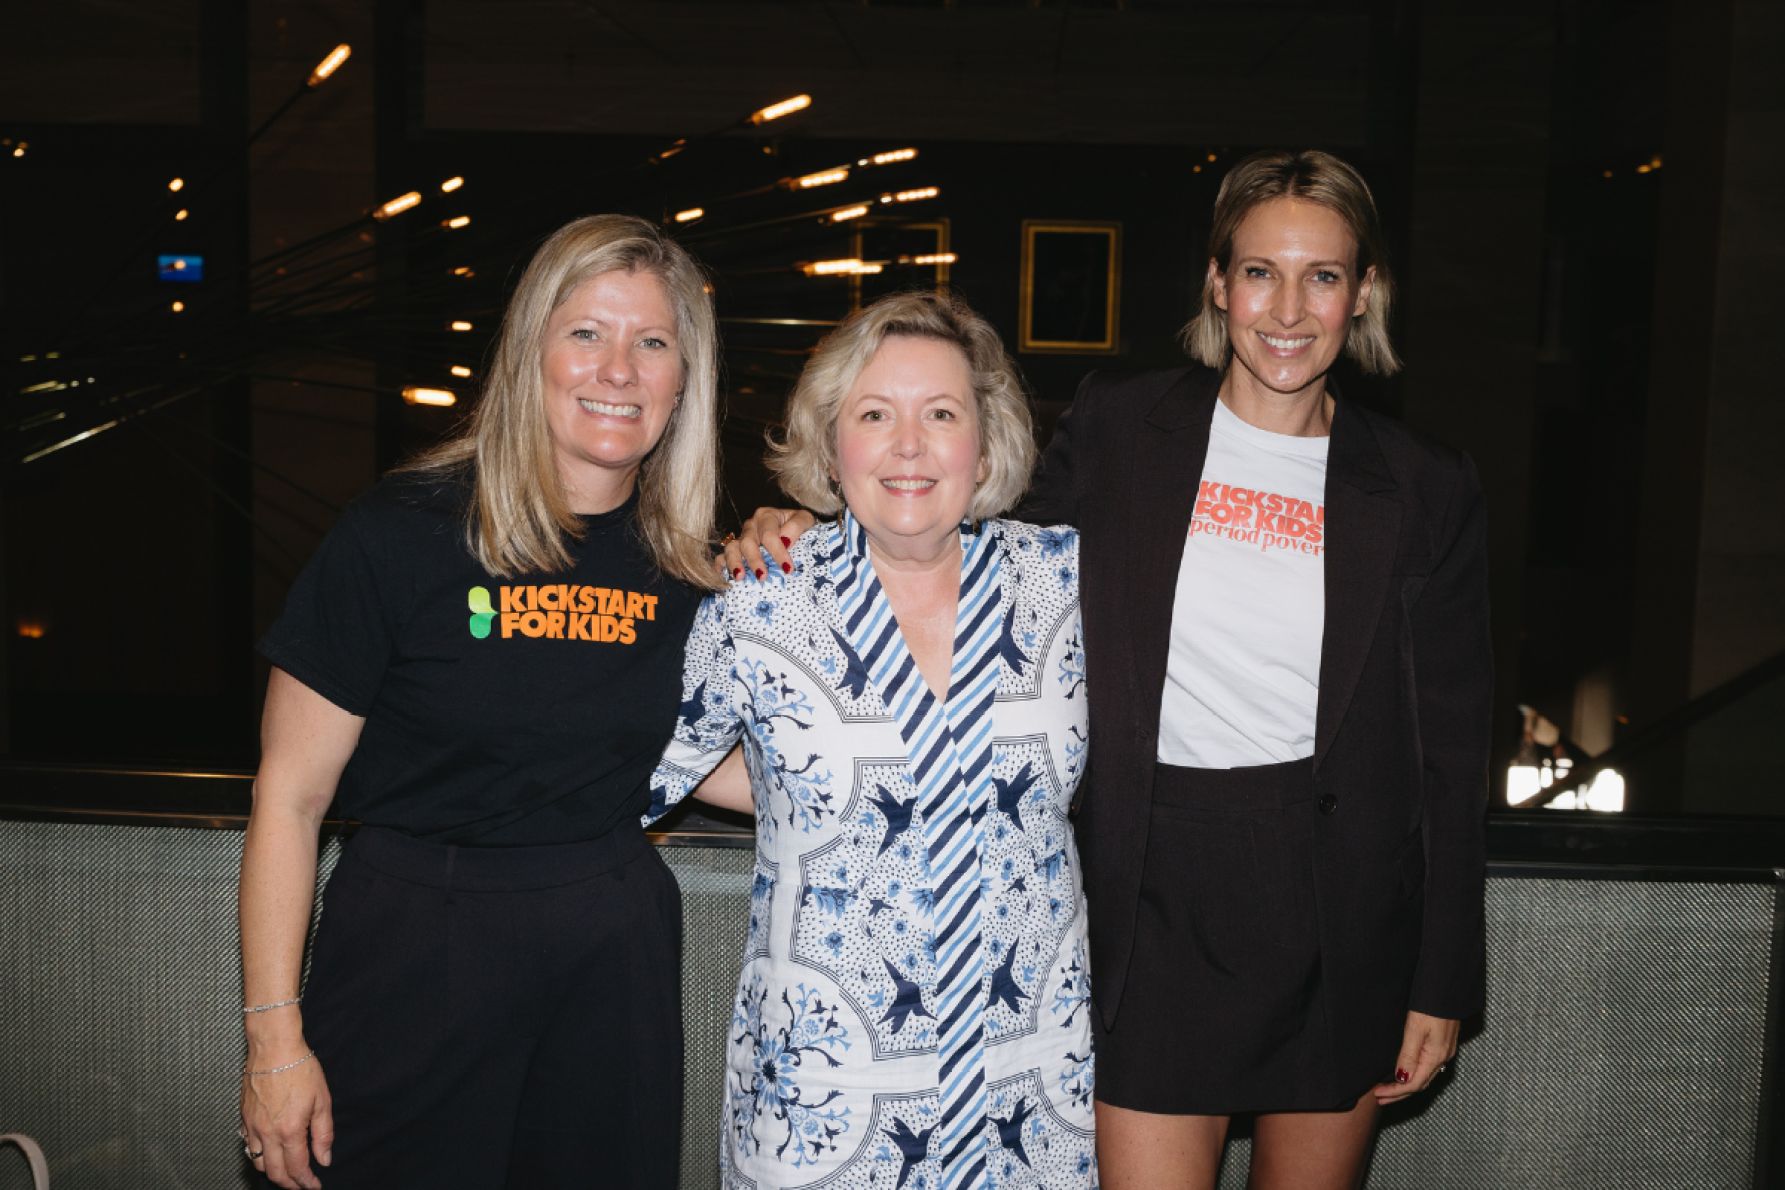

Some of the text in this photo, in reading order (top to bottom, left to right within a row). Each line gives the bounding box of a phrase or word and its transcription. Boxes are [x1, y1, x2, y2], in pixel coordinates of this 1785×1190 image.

[1190, 519, 1261, 544] period
[1195, 500, 1323, 543] FOR KIDS
[500, 584, 659, 621] KICKSTART
[501, 611, 637, 645] FOR KIDS
